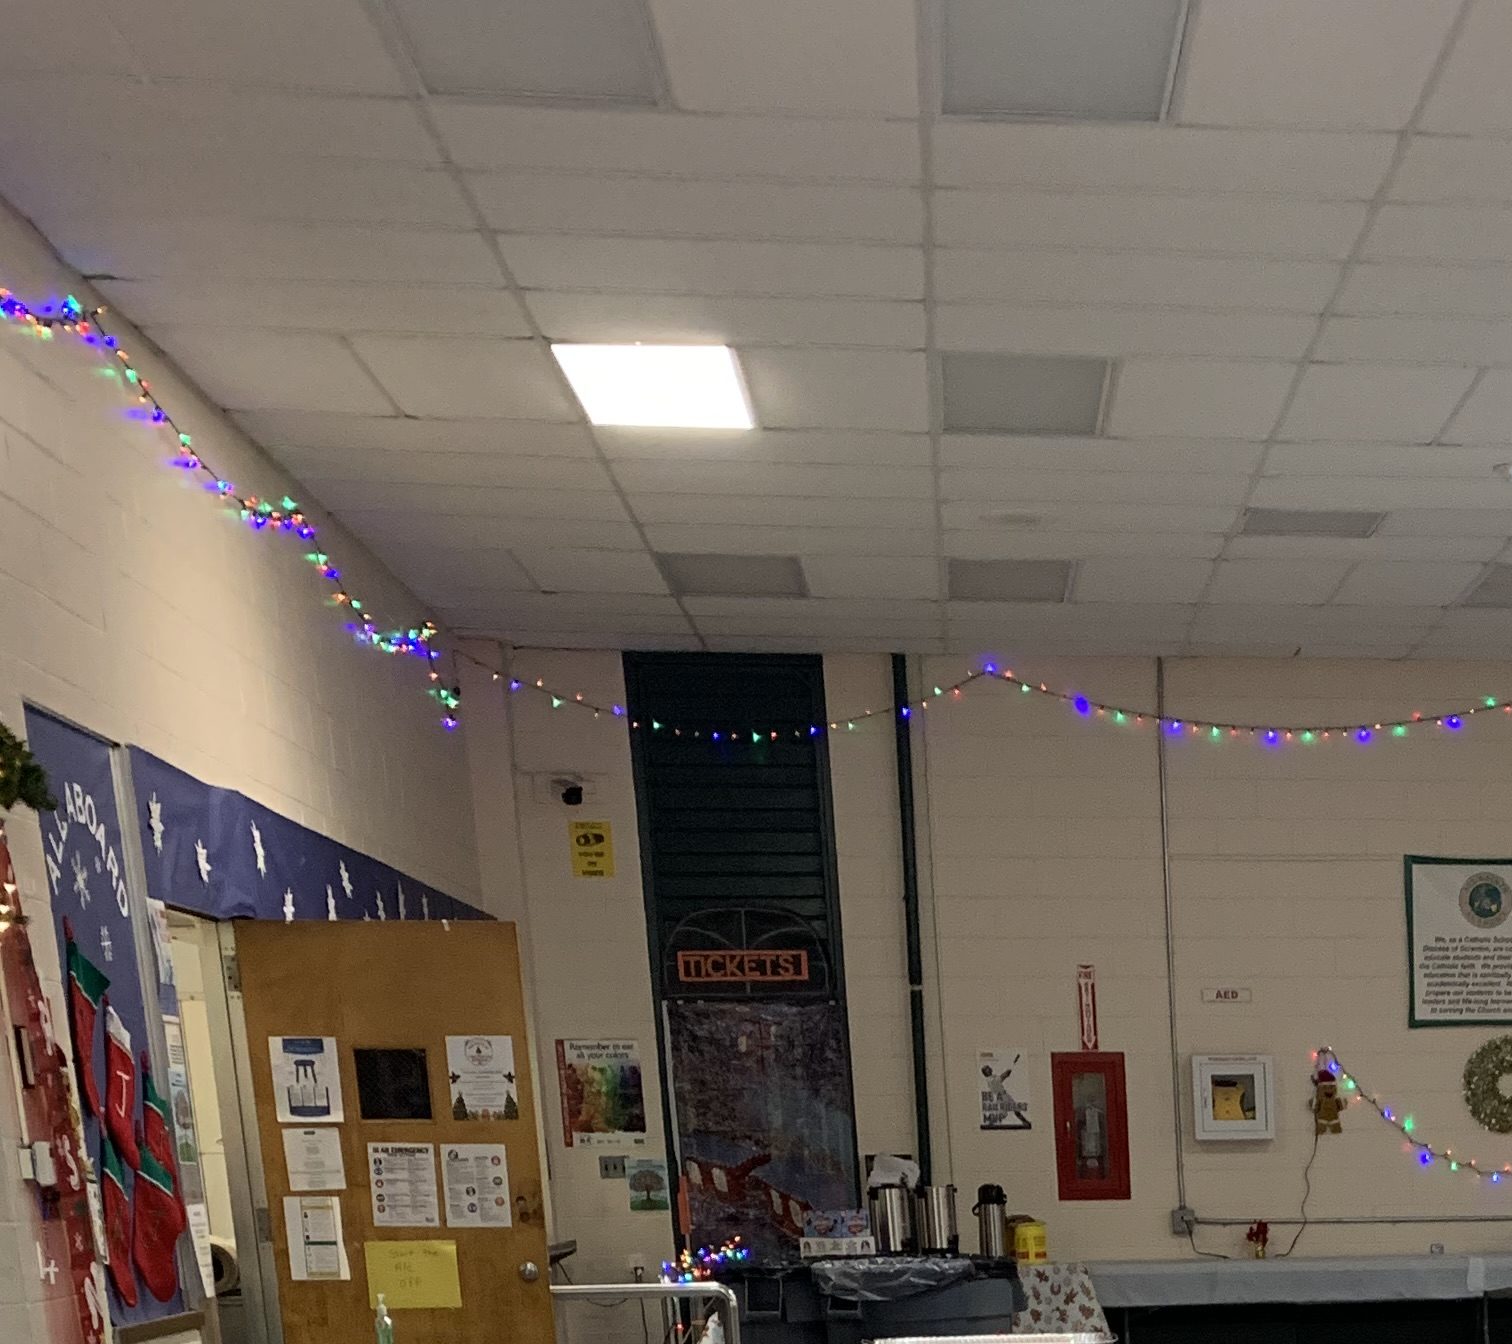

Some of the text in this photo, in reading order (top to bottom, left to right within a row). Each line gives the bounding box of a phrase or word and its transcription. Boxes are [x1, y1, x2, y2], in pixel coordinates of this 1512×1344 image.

[46, 782, 128, 917] ALL ABOARD
[683, 955, 795, 977] TICKETS
[1215, 990, 1238, 999] AED
